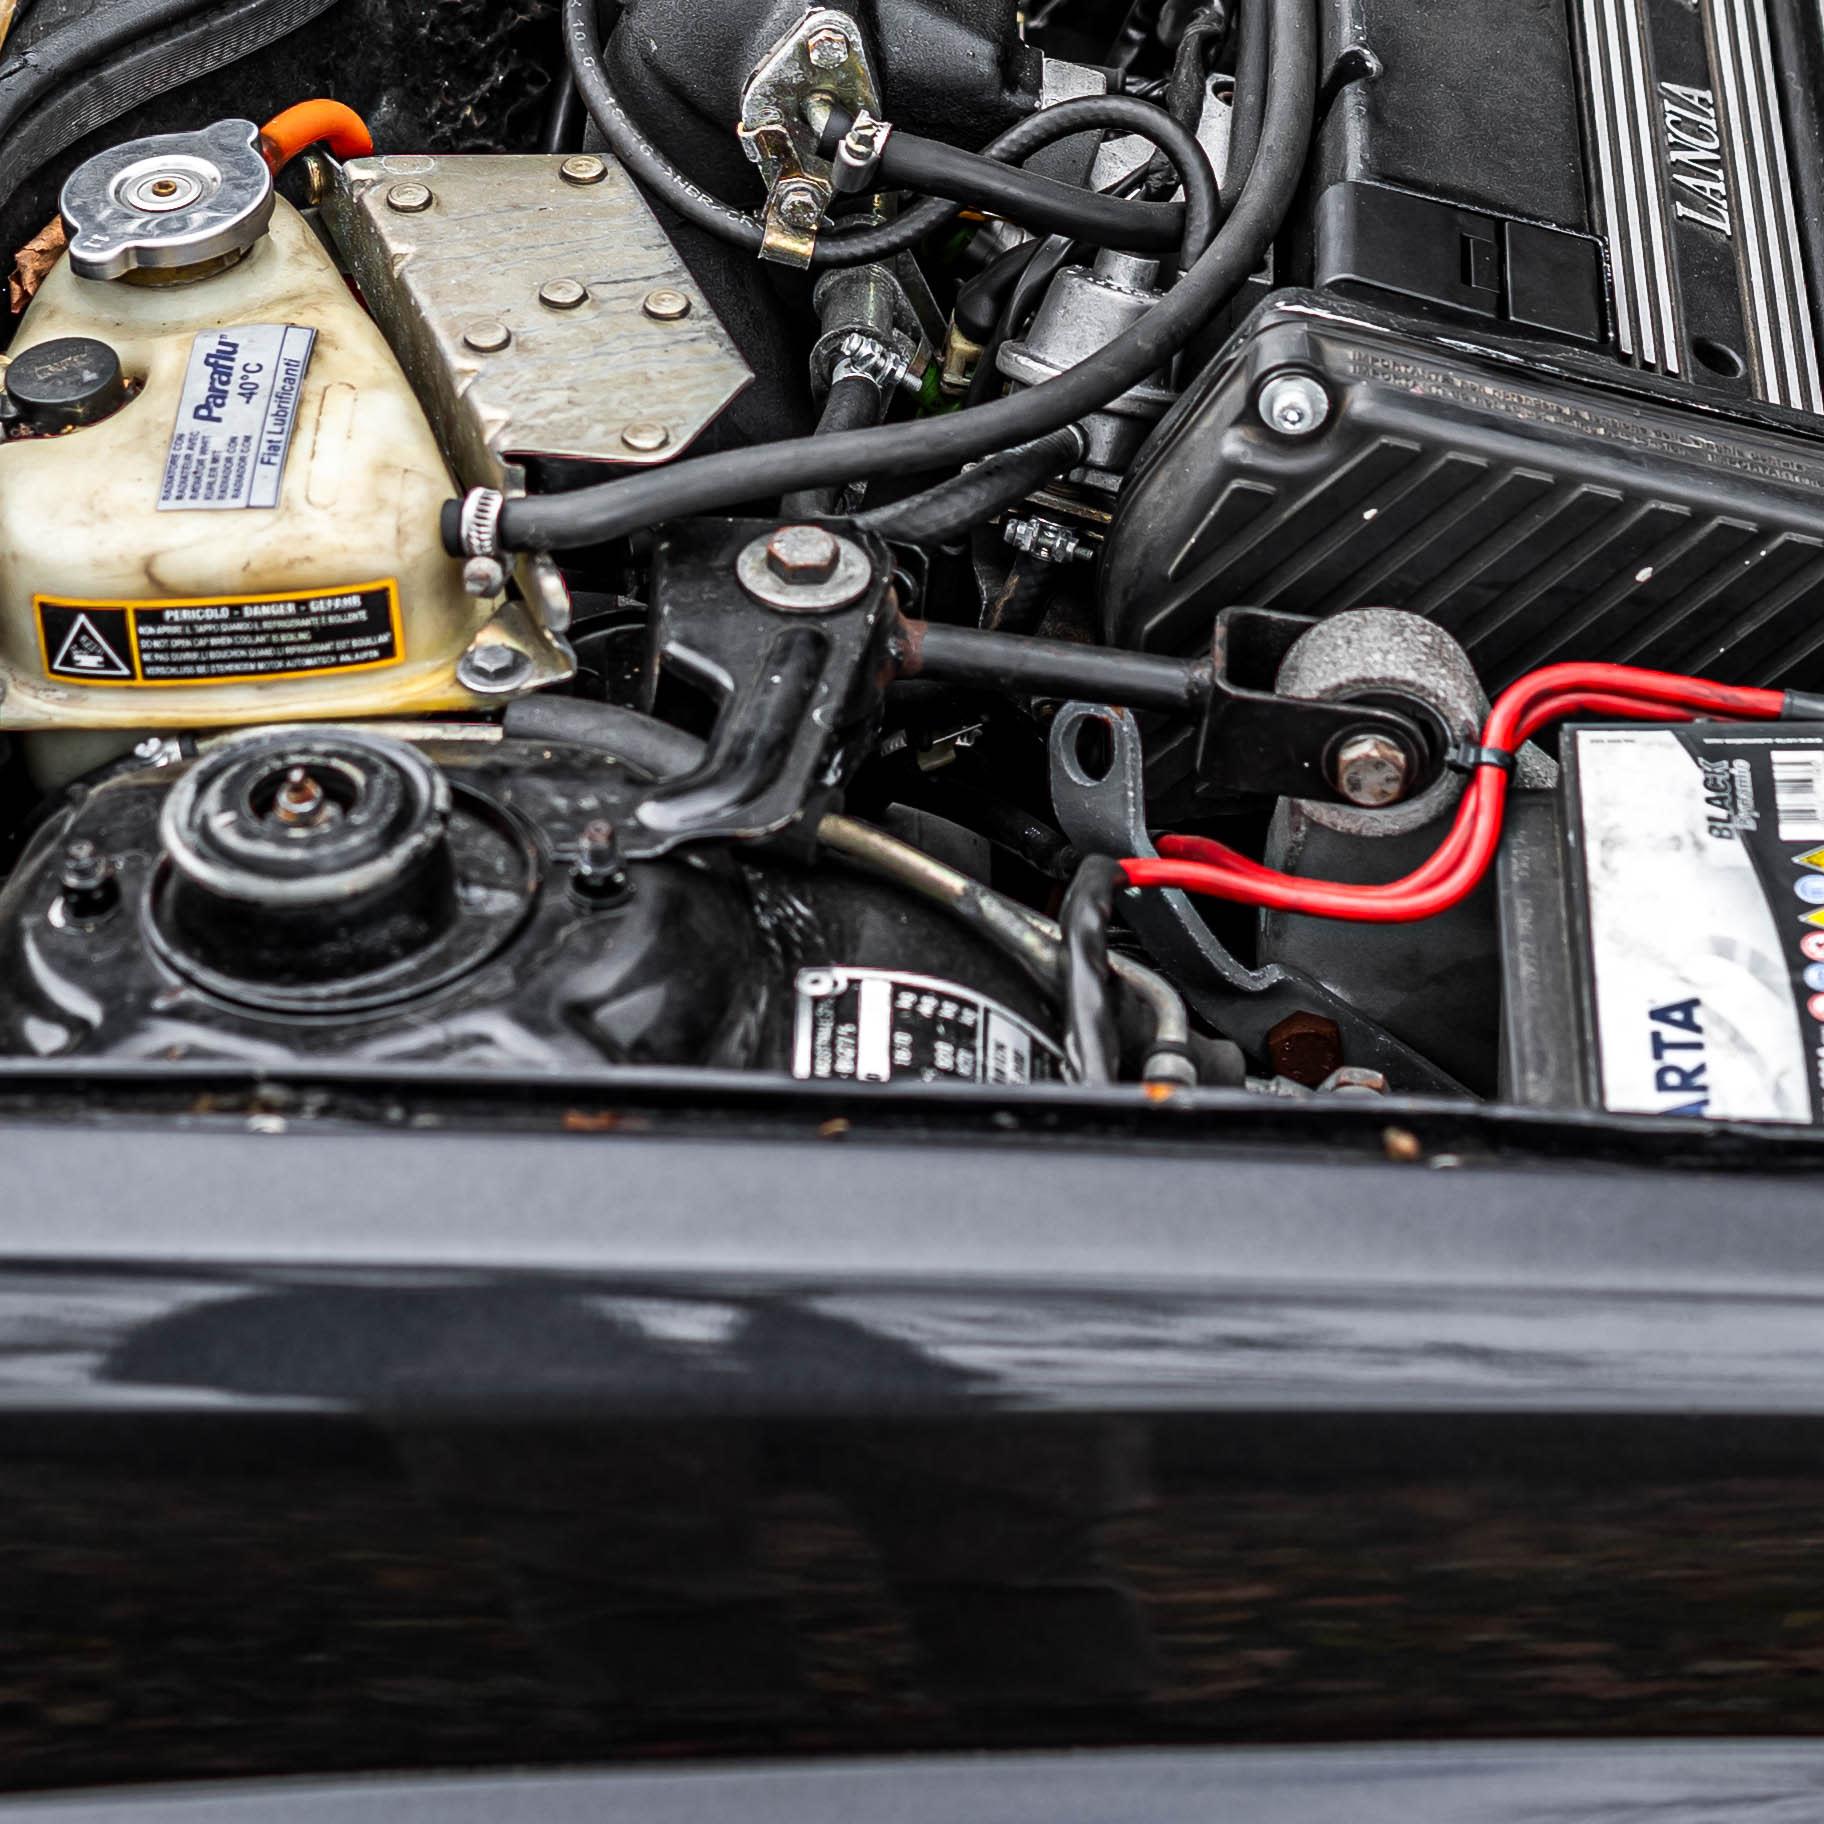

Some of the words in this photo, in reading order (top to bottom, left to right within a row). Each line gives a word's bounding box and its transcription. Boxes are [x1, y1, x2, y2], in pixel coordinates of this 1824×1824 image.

[1660, 81, 1733, 236] LANCIA
[267, 357, 301, 436] Lubrificanti
[260, 439, 281, 467] Fiat
[164, 606, 230, 622] PERICOLO
[242, 602, 297, 618] DANGER
[308, 595, 362, 613] GEFAHR
[1697, 757, 1735, 840] BLACK
